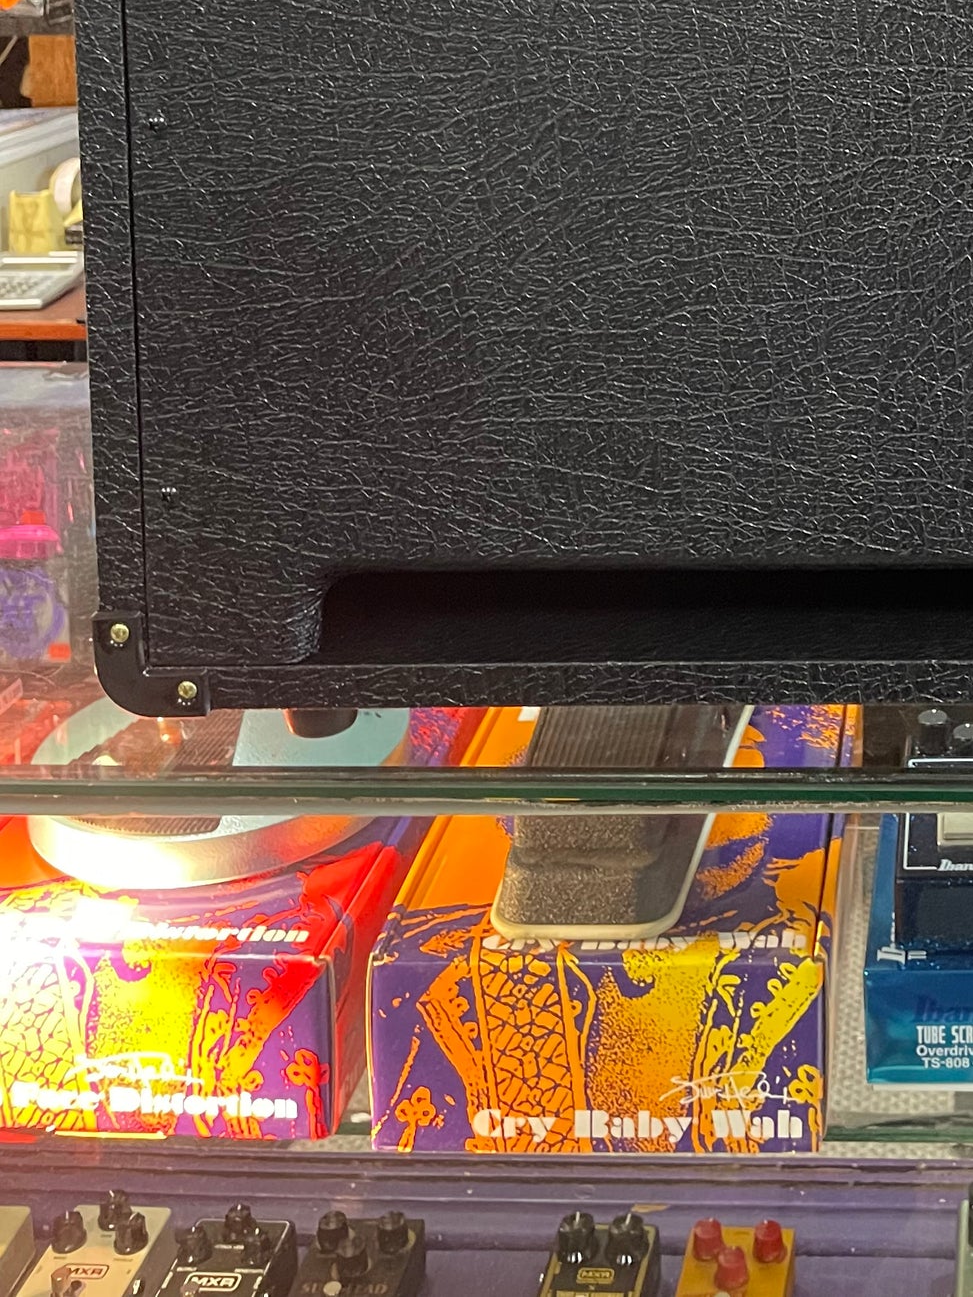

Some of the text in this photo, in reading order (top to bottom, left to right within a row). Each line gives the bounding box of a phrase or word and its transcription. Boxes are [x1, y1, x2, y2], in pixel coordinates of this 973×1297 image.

[718, 931, 807, 950] Wah
[915, 1024, 946, 1044] TUBE
[921, 1057, 970, 1069] TS-808
[473, 1109, 803, 1142] Cry Baby Wah
